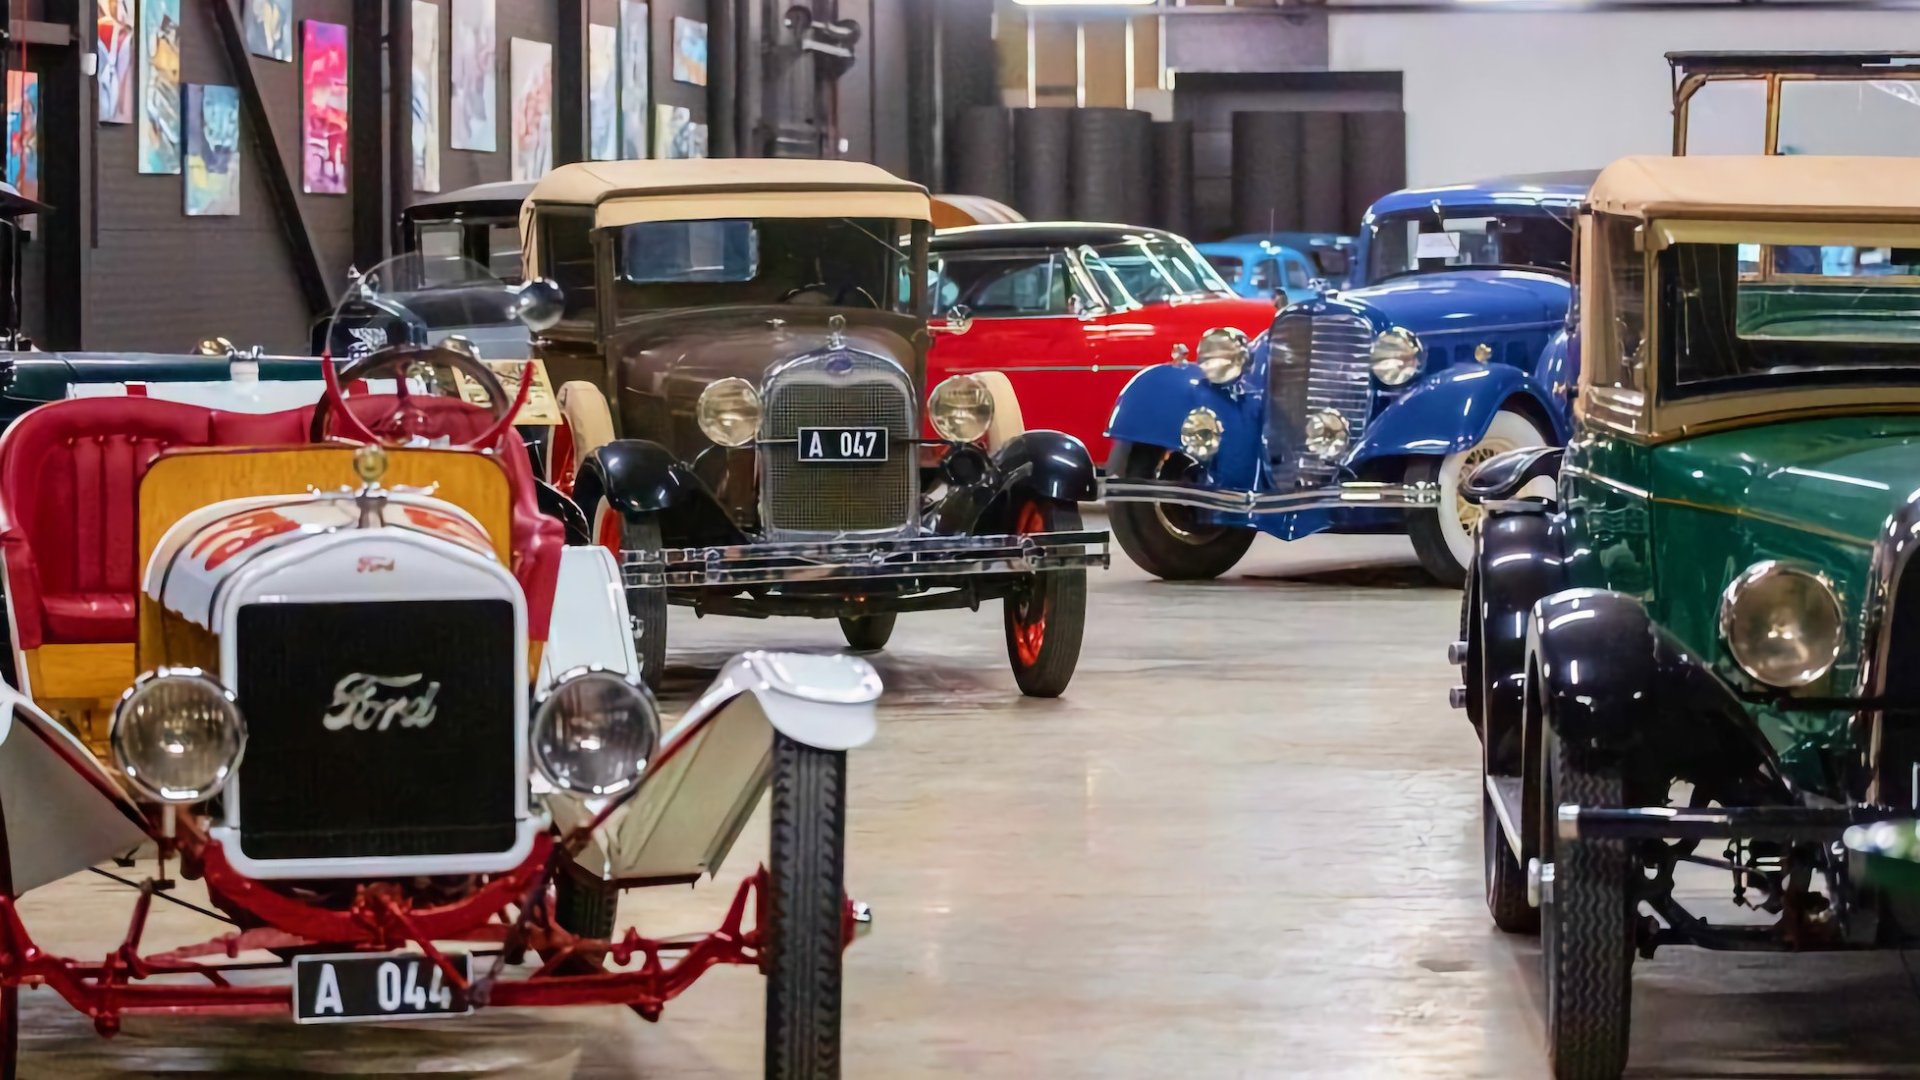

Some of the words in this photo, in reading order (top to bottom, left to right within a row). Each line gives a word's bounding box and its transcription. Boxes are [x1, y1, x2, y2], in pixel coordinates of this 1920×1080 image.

[808, 431, 823, 457] A
[840, 431, 877, 457] 047
[357, 556, 395, 573] Ford
[323, 672, 441, 730] Ford
[314, 963, 344, 1014] A
[377, 961, 451, 1012] 044
